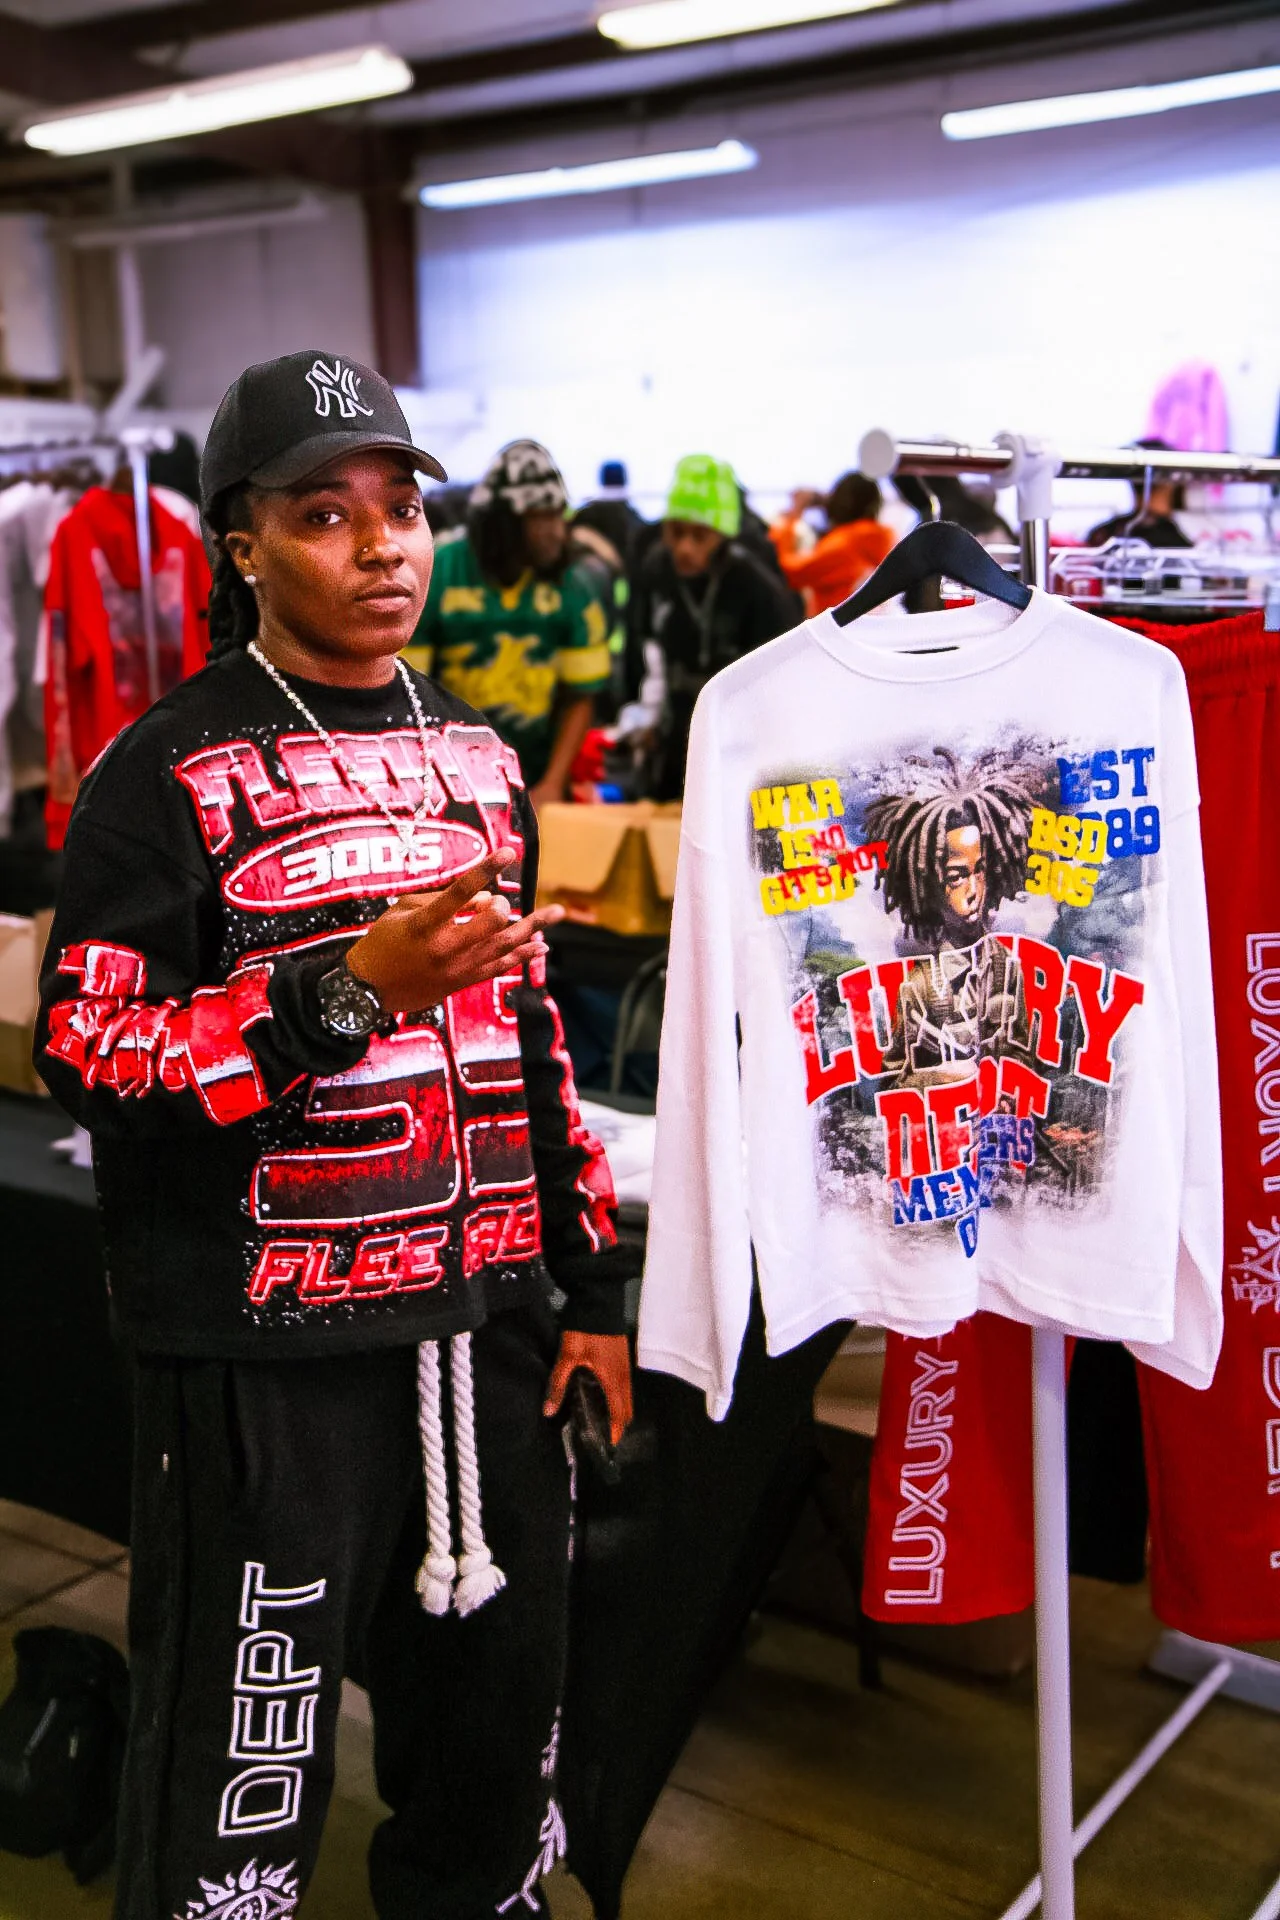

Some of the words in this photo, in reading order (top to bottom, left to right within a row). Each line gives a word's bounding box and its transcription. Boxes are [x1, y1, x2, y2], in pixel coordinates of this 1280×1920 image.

[305, 360, 375, 418] NY
[750, 778, 845, 830] WAR
[1057, 747, 1155, 806] EST
[778, 828, 819, 870] IS
[248, 1224, 449, 1305] FLEE
[884, 1350, 960, 1606] LUXURY
[217, 1560, 327, 1839] DEPT
